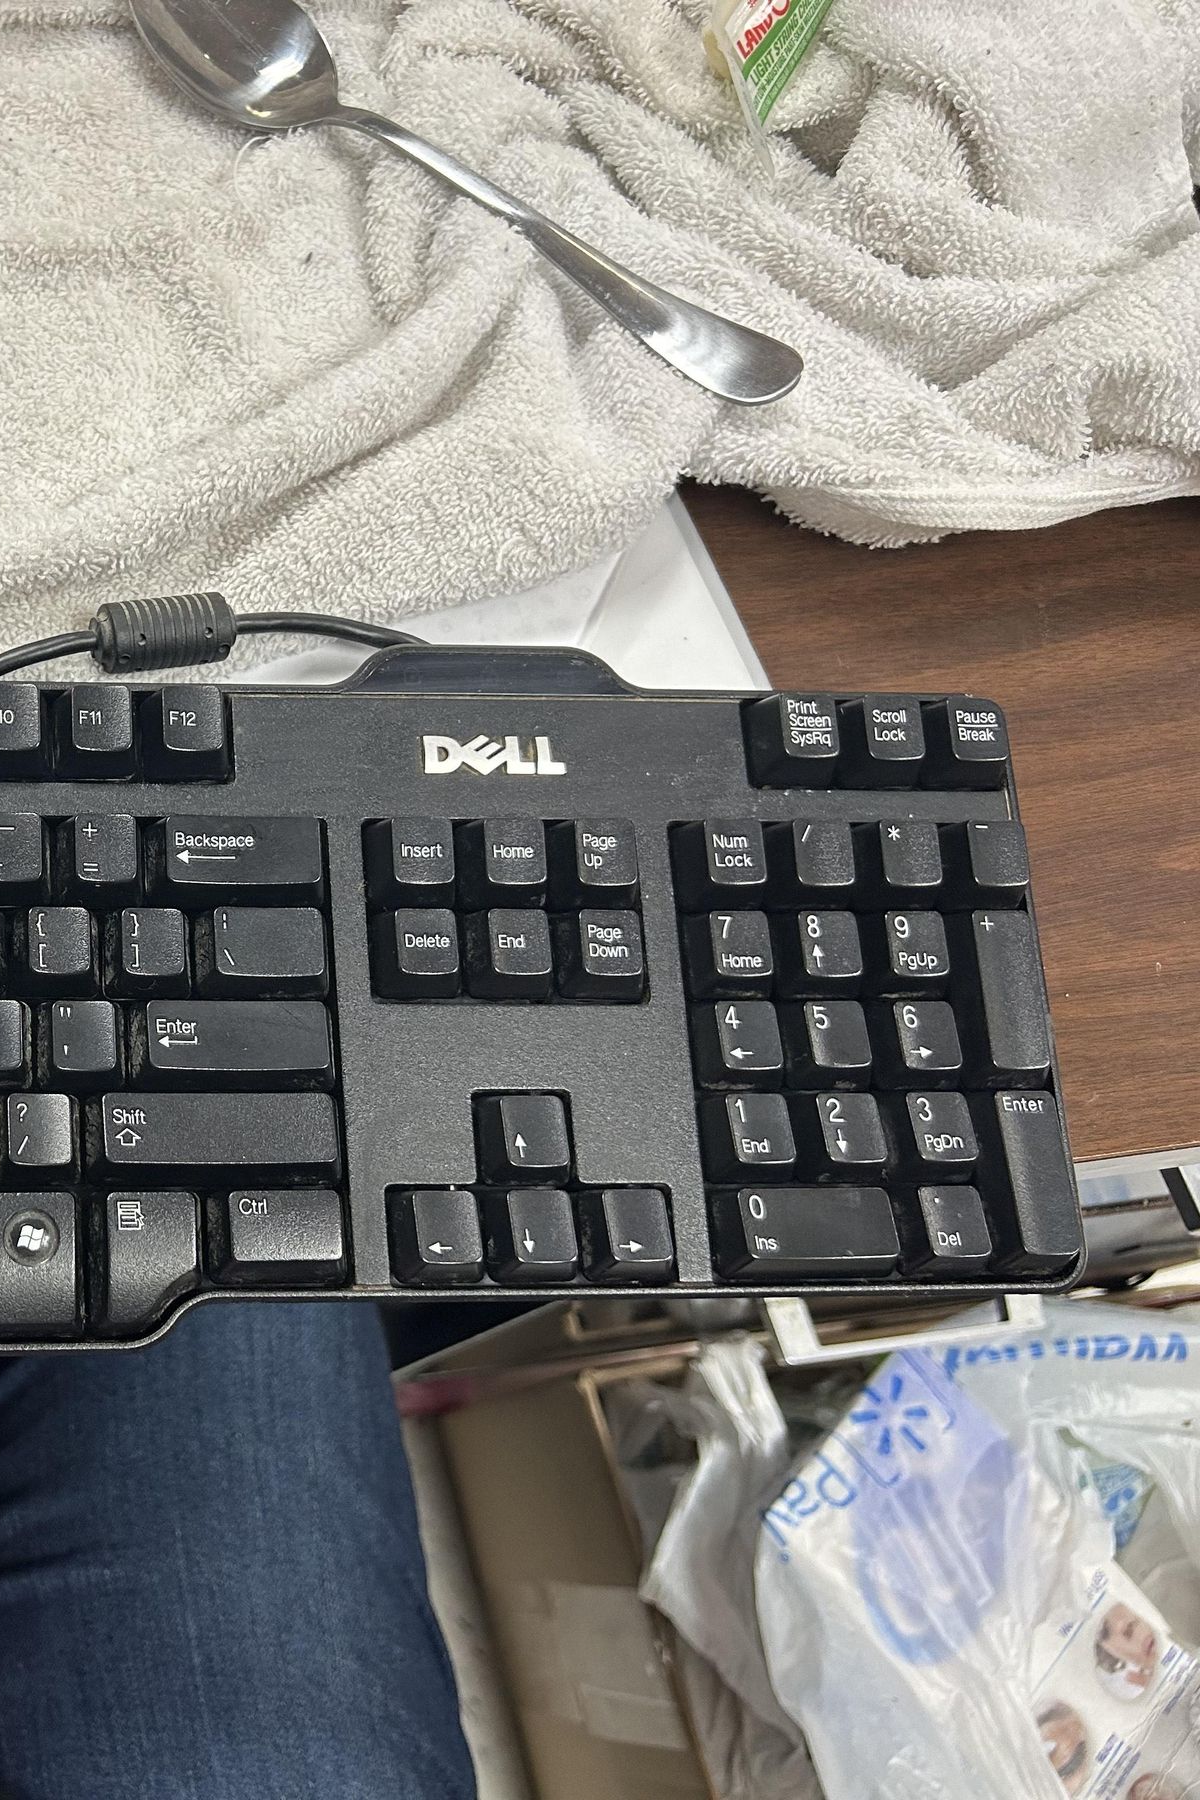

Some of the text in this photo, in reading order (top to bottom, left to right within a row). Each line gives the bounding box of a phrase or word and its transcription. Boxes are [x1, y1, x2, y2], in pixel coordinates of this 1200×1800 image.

[750, 49, 777, 87] LIGHT
[774, 13, 799, 57] STRING
[786, 699, 818, 715] Print
[79, 710, 102, 725] F11
[169, 710, 197, 727] F12
[789, 714, 832, 729] Screen
[872, 709, 907, 724] Scroll
[955, 710, 996, 724] Pause
[790, 730, 832, 747] SysRq
[874, 726, 907, 742] Lock
[958, 727, 996, 742] Break
[422, 734, 567, 776] DELL
[82, 822, 98, 838] +
[801, 824, 811, 842] /
[175, 831, 255, 851] Backspace
[582, 833, 617, 851] Page
[712, 833, 748, 849] Num
[401, 843, 443, 858] Insert
[493, 844, 534, 859] Home
[83, 862, 99, 872] =
[584, 853, 603, 870] Up
[714, 852, 753, 867] Lock
[36, 913, 46, 937] {
[129, 913, 140, 937] }
[717, 915, 732, 939] 7
[806, 914, 821, 938] 8
[894, 915, 910, 939] 9
[979, 915, 994, 931] +
[404, 933, 451, 948] Delete
[498, 934, 526, 949] End
[587, 924, 622, 944] Page
[38, 943, 48, 968] [
[130, 942, 141, 969] ]
[223, 949, 235, 966] \
[588, 942, 629, 958] Down
[721, 953, 763, 968] Home
[898, 951, 938, 971] PgUp
[724, 1005, 741, 1030] 4
[812, 1005, 829, 1030] 5
[902, 1005, 918, 1029] 6
[156, 1018, 197, 1035] Enter
[16, 1103, 28, 1122] ?
[734, 1098, 746, 1123] 1
[825, 1098, 845, 1123] 2
[916, 1097, 933, 1122] 3
[1002, 1096, 1043, 1112] Enter
[112, 1108, 147, 1125] Shift
[17, 1135, 29, 1155] /
[741, 1138, 770, 1154] End
[924, 1134, 964, 1153] PgDn
[238, 1198, 268, 1215] Ctrl
[748, 1194, 765, 1220] 0
[754, 1235, 778, 1251] Ins
[937, 1231, 962, 1246] Del
